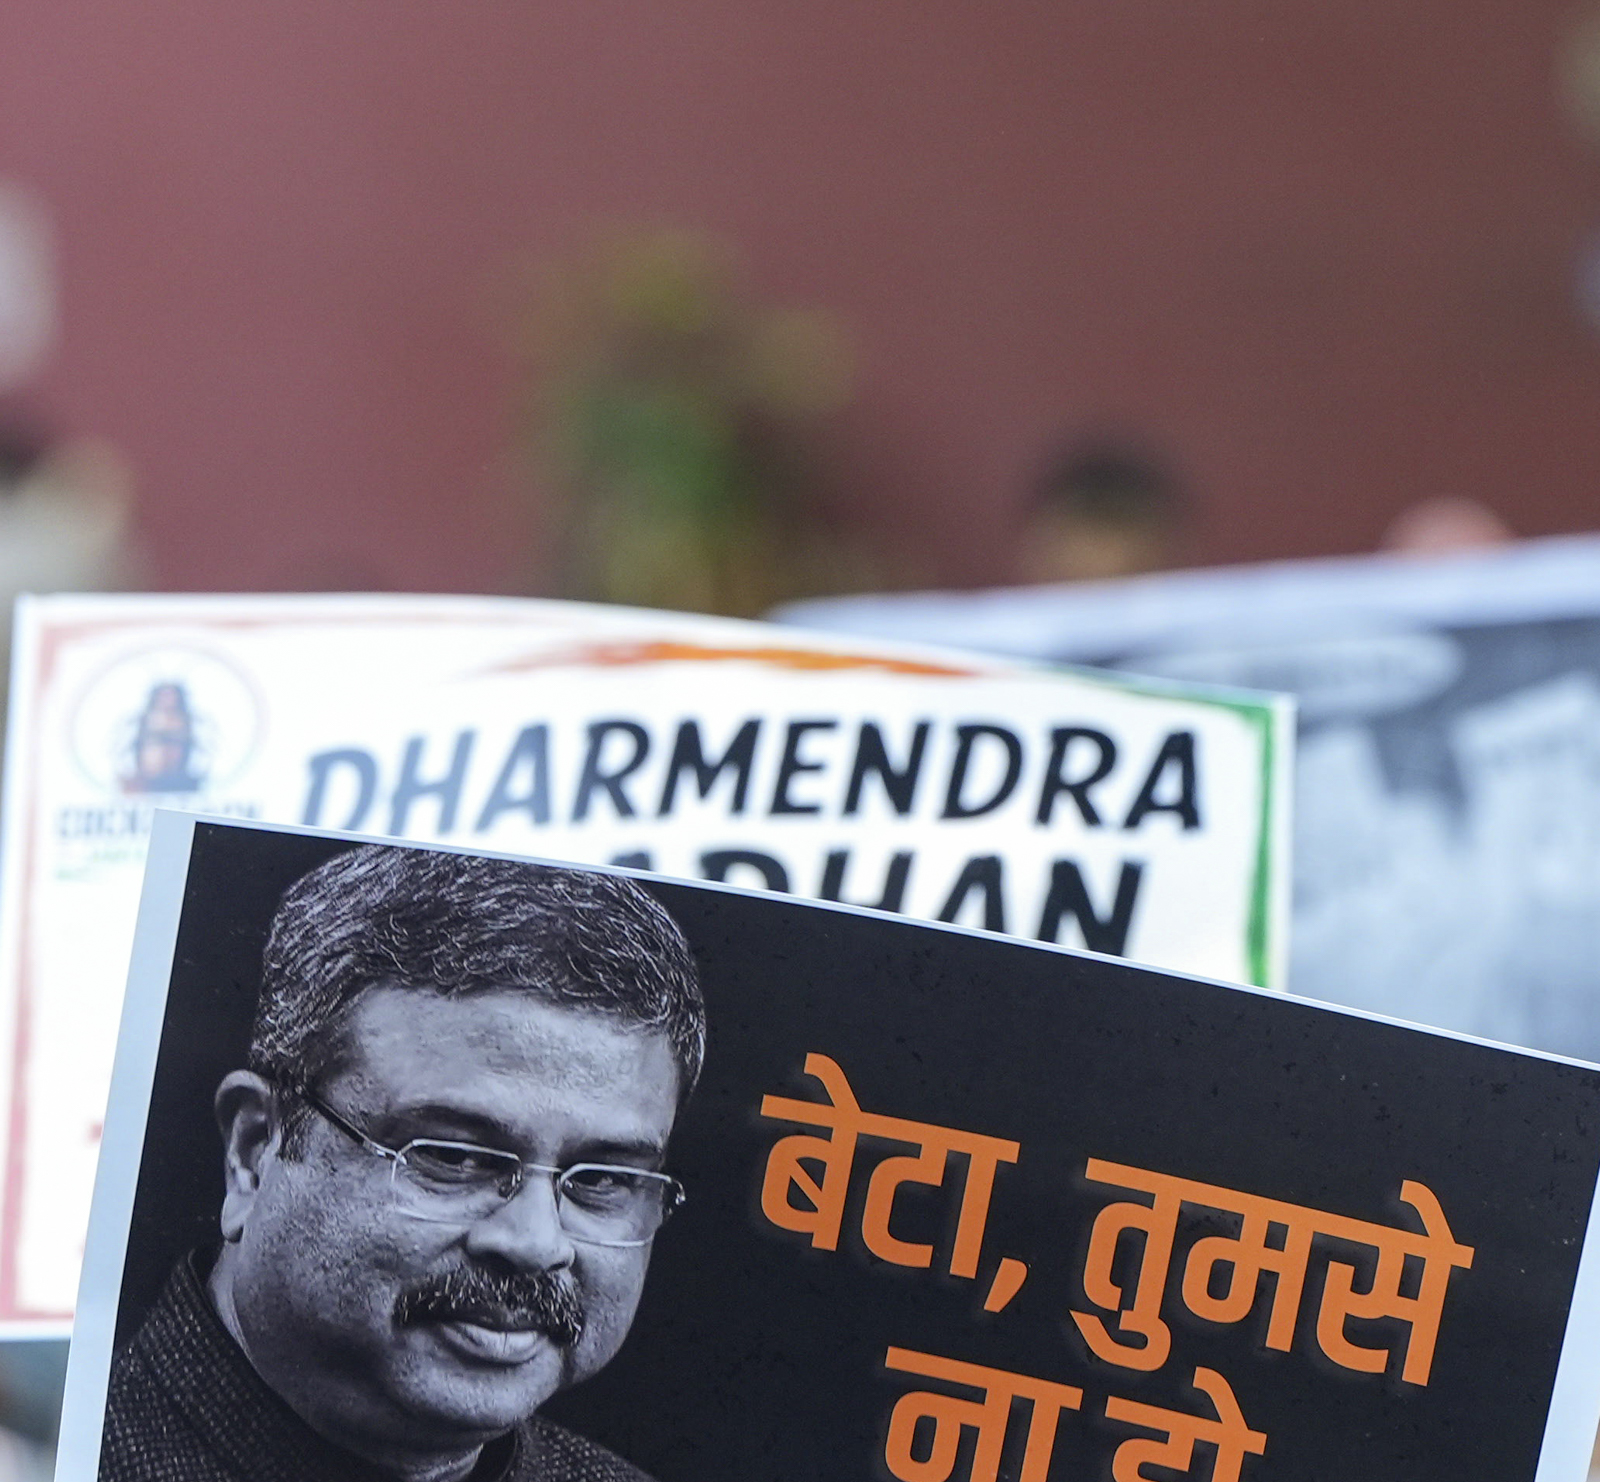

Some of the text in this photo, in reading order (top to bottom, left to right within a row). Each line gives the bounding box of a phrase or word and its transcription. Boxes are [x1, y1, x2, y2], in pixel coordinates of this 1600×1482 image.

[302, 717, 1204, 834] DHARMENDRA
[761, 1052, 1475, 1387] बेटा, तुमसे
